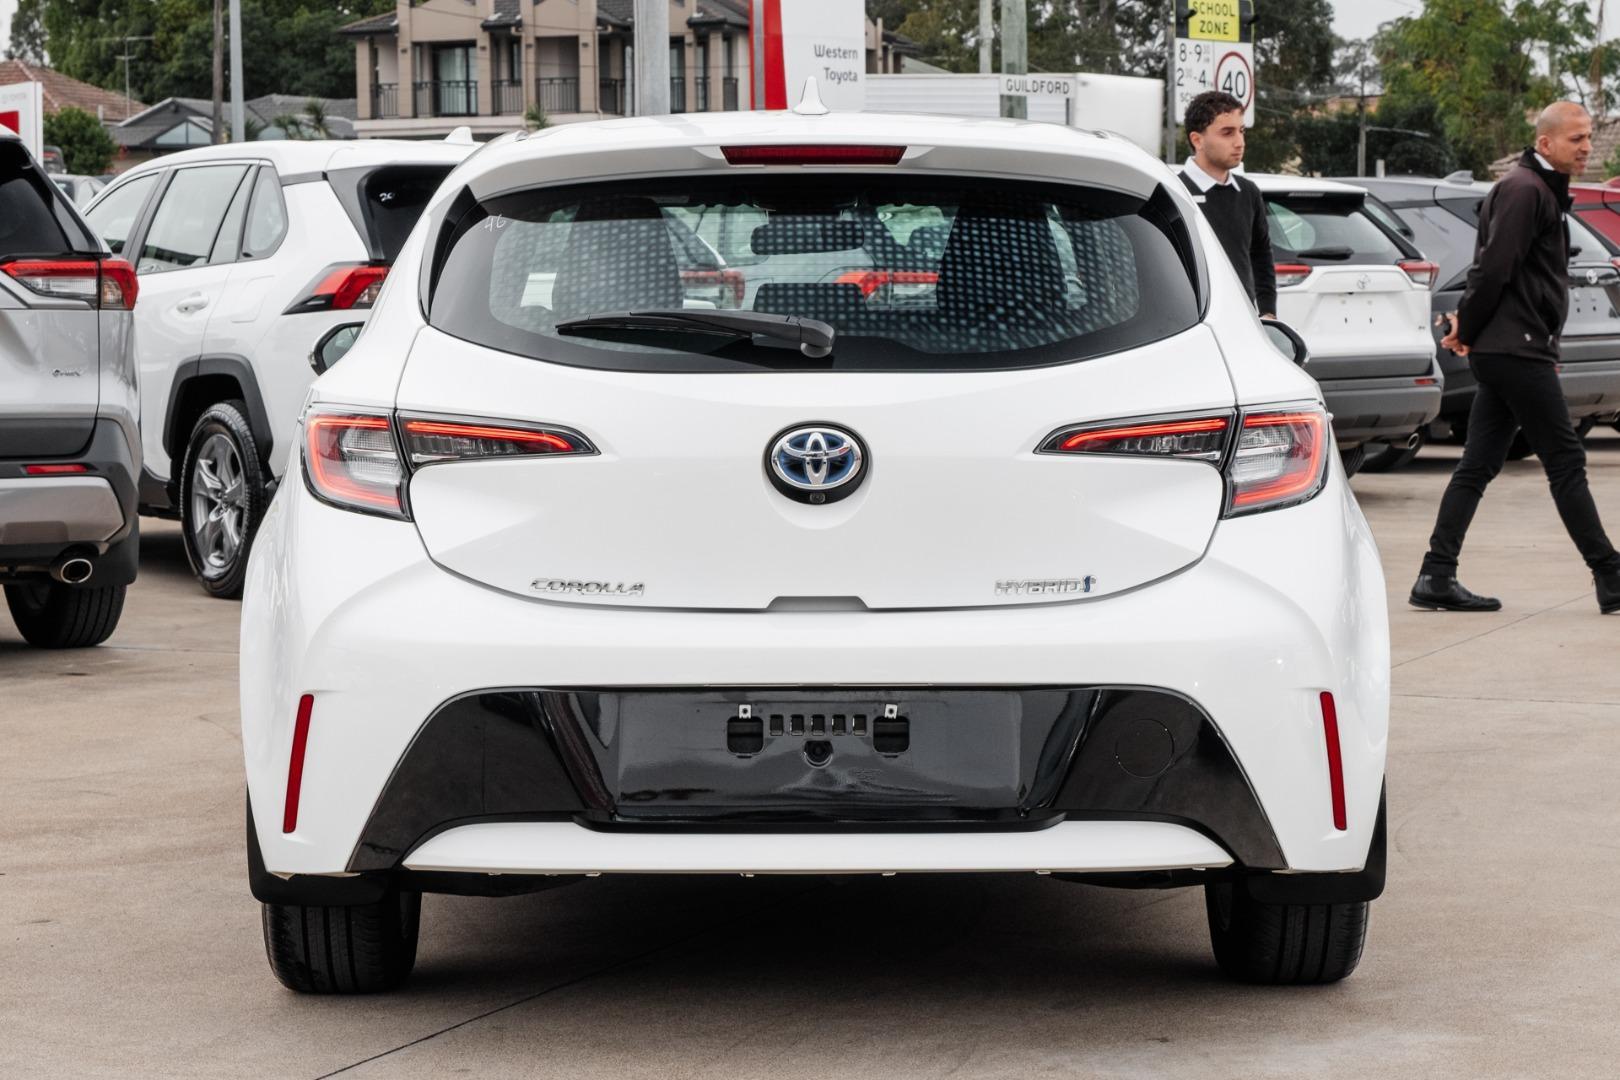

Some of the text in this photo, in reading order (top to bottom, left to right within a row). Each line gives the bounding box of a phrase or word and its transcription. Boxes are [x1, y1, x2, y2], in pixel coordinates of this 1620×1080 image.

[1192, 1, 1236, 17] SCHOOL
[1199, 20, 1229, 35] ZONE
[813, 44, 858, 59] Western
[824, 67, 858, 85] Toyota
[1222, 70, 1246, 98] 40
[1006, 79, 1070, 95] GUILDFORD
[529, 578, 645, 597] COROLLA
[994, 577, 1081, 596] HYBRID
